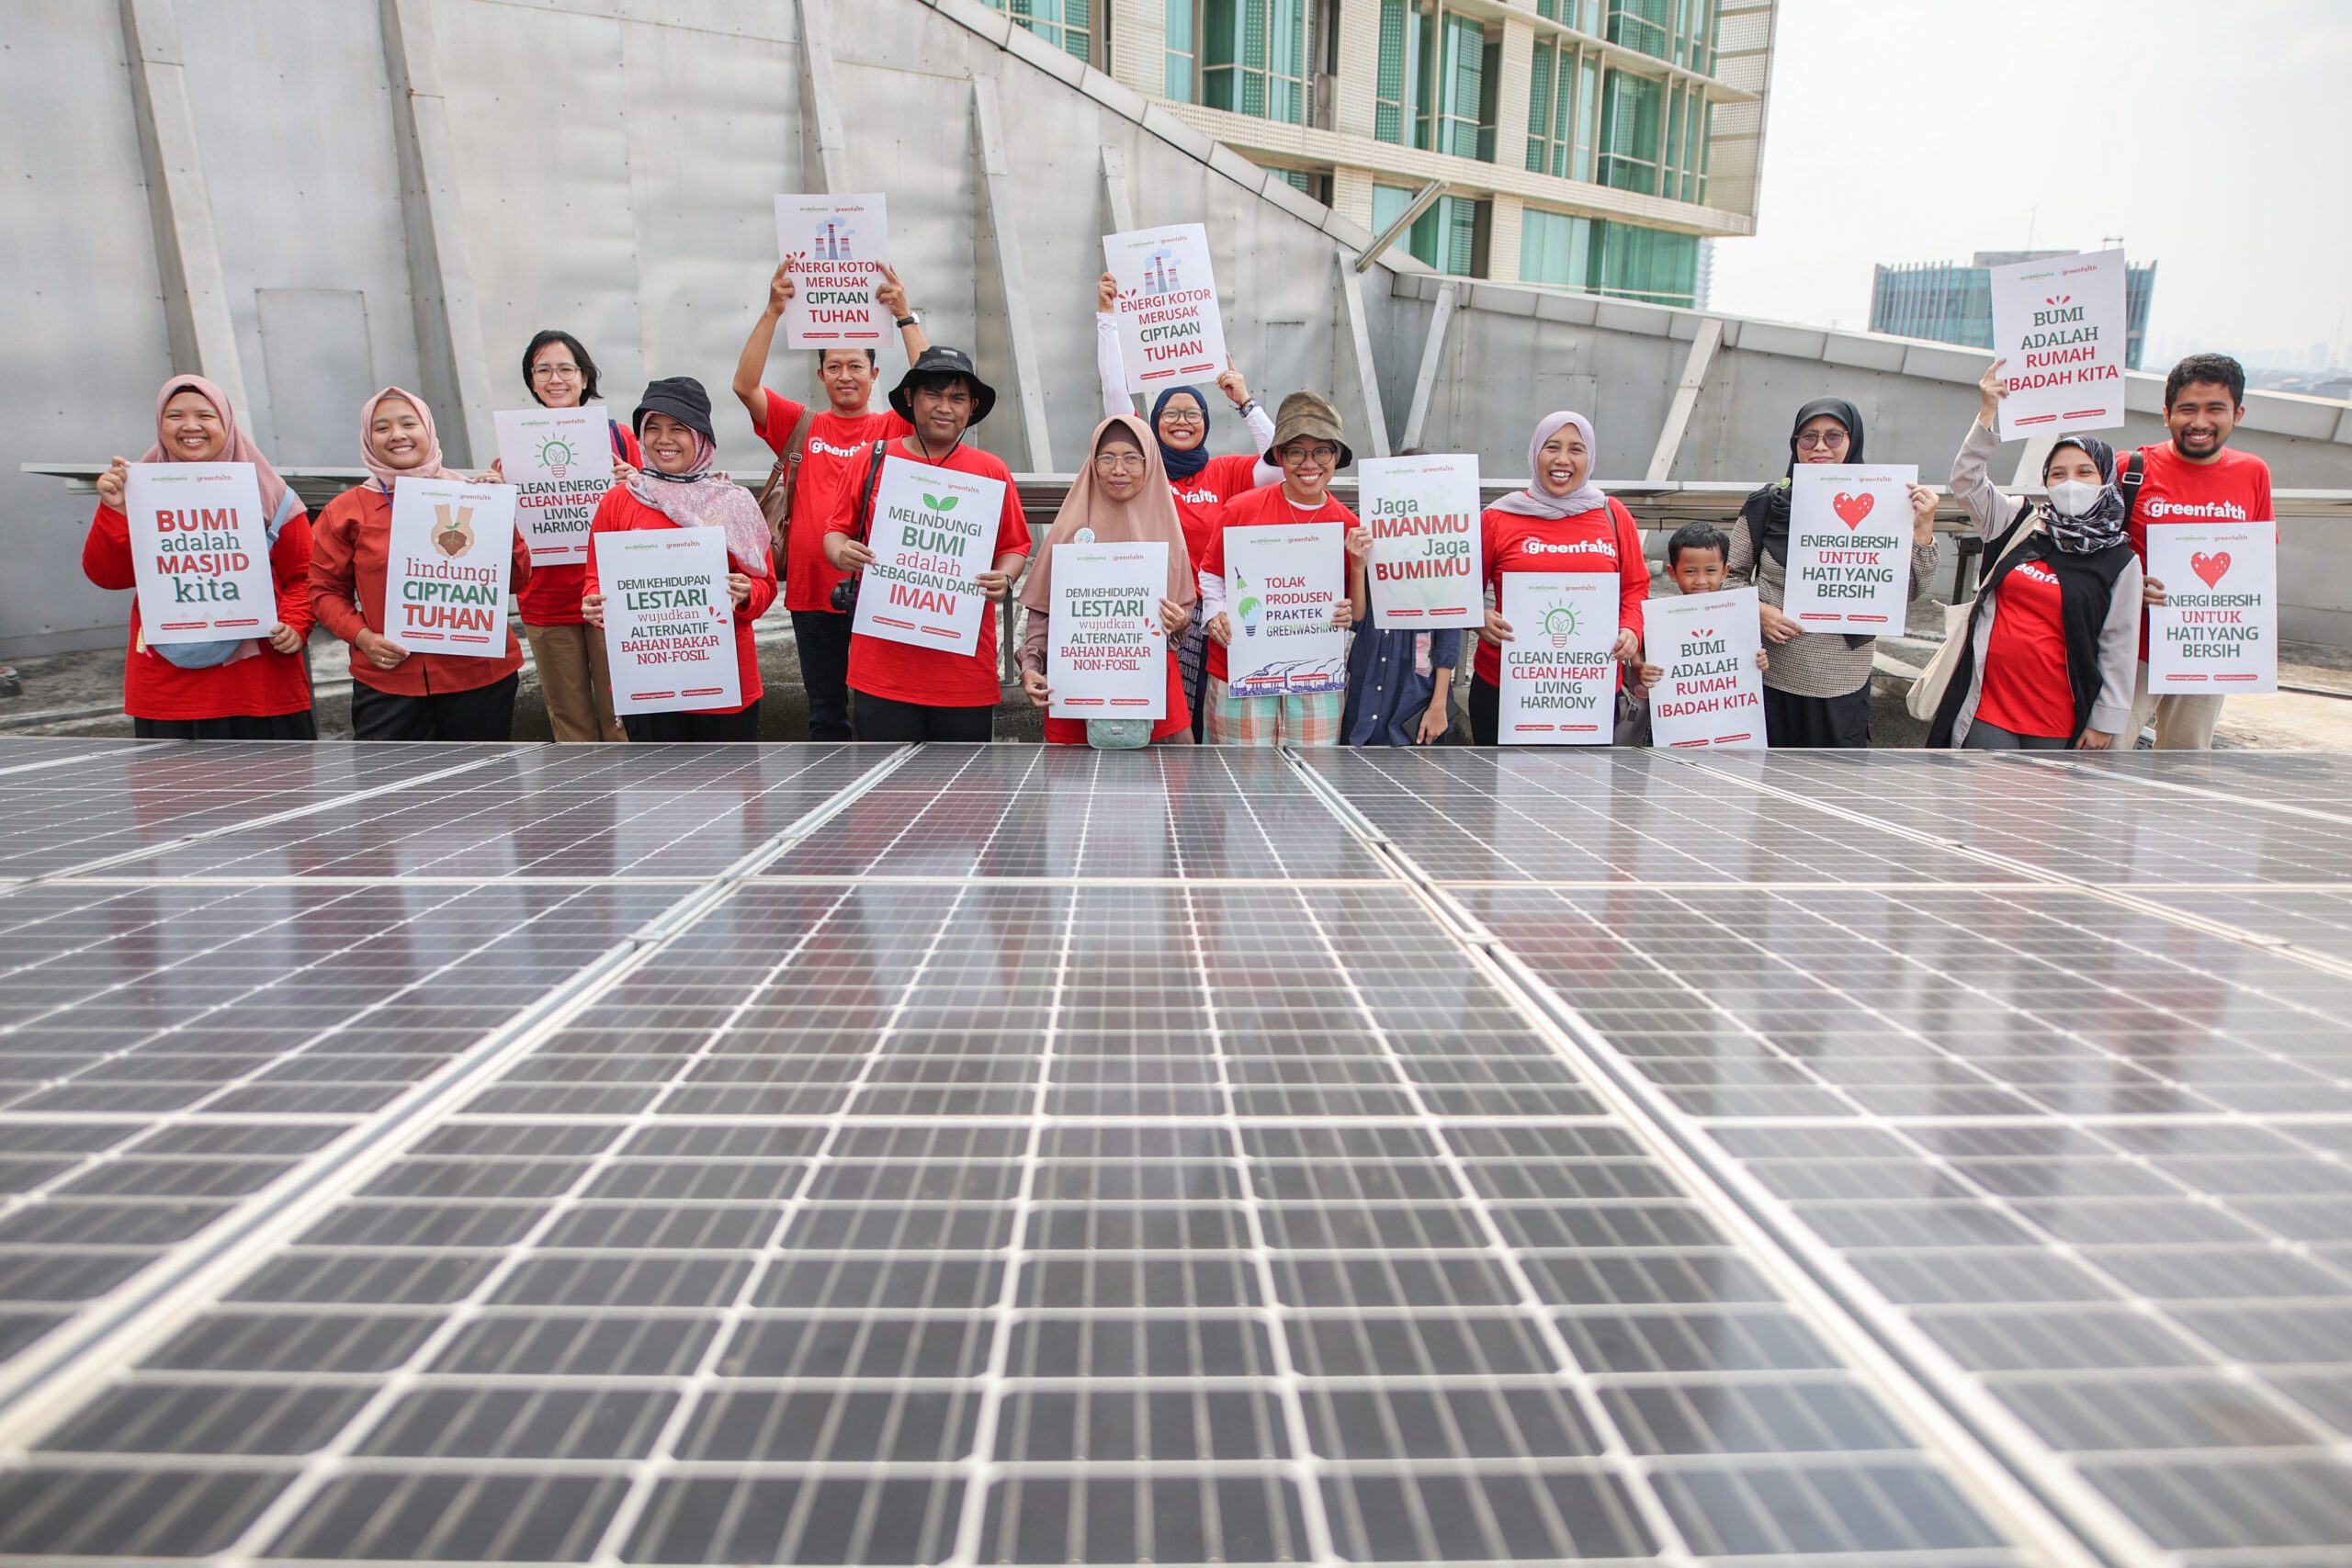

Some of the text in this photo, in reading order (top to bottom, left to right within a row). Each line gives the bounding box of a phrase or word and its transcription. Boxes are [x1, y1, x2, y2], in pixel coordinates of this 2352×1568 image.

[788, 262, 834, 272] ENERGI
[2063, 265, 2097, 276] greenfaith
[807, 277, 868, 287] MERUSAK
[807, 292, 868, 304] CIPTAAN
[1121, 289, 1211, 312] ENERGI KOTOR
[809, 310, 869, 322] TUHAN
[1139, 306, 1198, 325] MERUSAK
[2034, 307, 2084, 326] BUMI
[1141, 321, 1200, 343] CIPTAAN
[2021, 327, 2098, 349] ADALAH
[1145, 340, 1203, 362] TUHAN
[2027, 346, 2095, 367] RUMAH
[2078, 365, 2118, 382] KITA
[812, 440, 866, 457] greenf
[197, 474, 232, 482] greenfaith
[560, 479, 610, 492] ENERGY
[948, 483, 979, 494] greenfaith
[520, 495, 562, 508] CLEAN
[1371, 498, 1419, 517] Jaga
[544, 507, 588, 520] LIVING
[2151, 500, 2245, 521] greenfaith
[156, 508, 239, 532] BUMI
[888, 506, 981, 536] MELINDUNGI
[1372, 514, 1469, 538] IMANMU
[161, 532, 241, 551] adalah
[666, 540, 700, 549] greenfaith
[901, 525, 966, 557] BUMI
[1288, 536, 1319, 544] greenfaith
[1801, 535, 1898, 548] ENERGI BERSIH
[1422, 539, 1470, 558] Jaga
[1529, 538, 1615, 558] greenfaith
[156, 553, 249, 577] MASJID
[897, 551, 961, 577] adalah
[1819, 551, 1880, 564] UNTUK
[405, 558, 497, 587] lindungi
[1375, 558, 1470, 581] BUMIMU
[1803, 567, 1893, 582] HATI YANG
[617, 575, 710, 590] DEMI KEHIDUPAN
[871, 563, 979, 596] SEBAGIAN DARI
[1265, 577, 1306, 588] TOLAK
[172, 576, 241, 604] kita
[403, 581, 498, 605] CIPTAAN
[1066, 588, 1148, 597] DEMI KEHIDUPAN
[1817, 584, 1874, 598] BERSIH
[627, 589, 707, 611] LESTARI
[889, 584, 956, 615] IMAN
[1266, 592, 1332, 604] PRODUSEN
[2211, 594, 2260, 606] BERSIH
[1072, 600, 1143, 617] LESTARI
[1267, 608, 1322, 620] PRAKTEK
[1705, 602, 1736, 611] greenfaith
[403, 604, 493, 631] TUHAN
[638, 610, 699, 624] wujudkan
[1080, 618, 1135, 631] wujudkan
[2181, 611, 2242, 623] UNTUK
[631, 622, 709, 637] ALTERNATIF
[2167, 626, 2258, 640] HATI YANG
[621, 636, 719, 652] BAHAN BAKAR
[1071, 633, 1143, 644] ALTERNATIF
[1061, 647, 1150, 657] BAHAN BAKAR
[1680, 640, 1725, 657] BUMI
[2183, 644, 2240, 658] BERSIH
[638, 649, 709, 665] NON-FOSIL
[1509, 652, 1612, 664] CLEAN ENERGY
[1073, 660, 1139, 671] NON-FOSIL
[1512, 667, 1607, 679] CLEAN HEART
[1671, 658, 1738, 678] ADALAH
[1535, 682, 1581, 694] LIVING
[1676, 676, 1736, 695] RUMAH
[1521, 696, 1596, 708] HARMONY
[1657, 693, 1758, 717] IBADAH KITA
